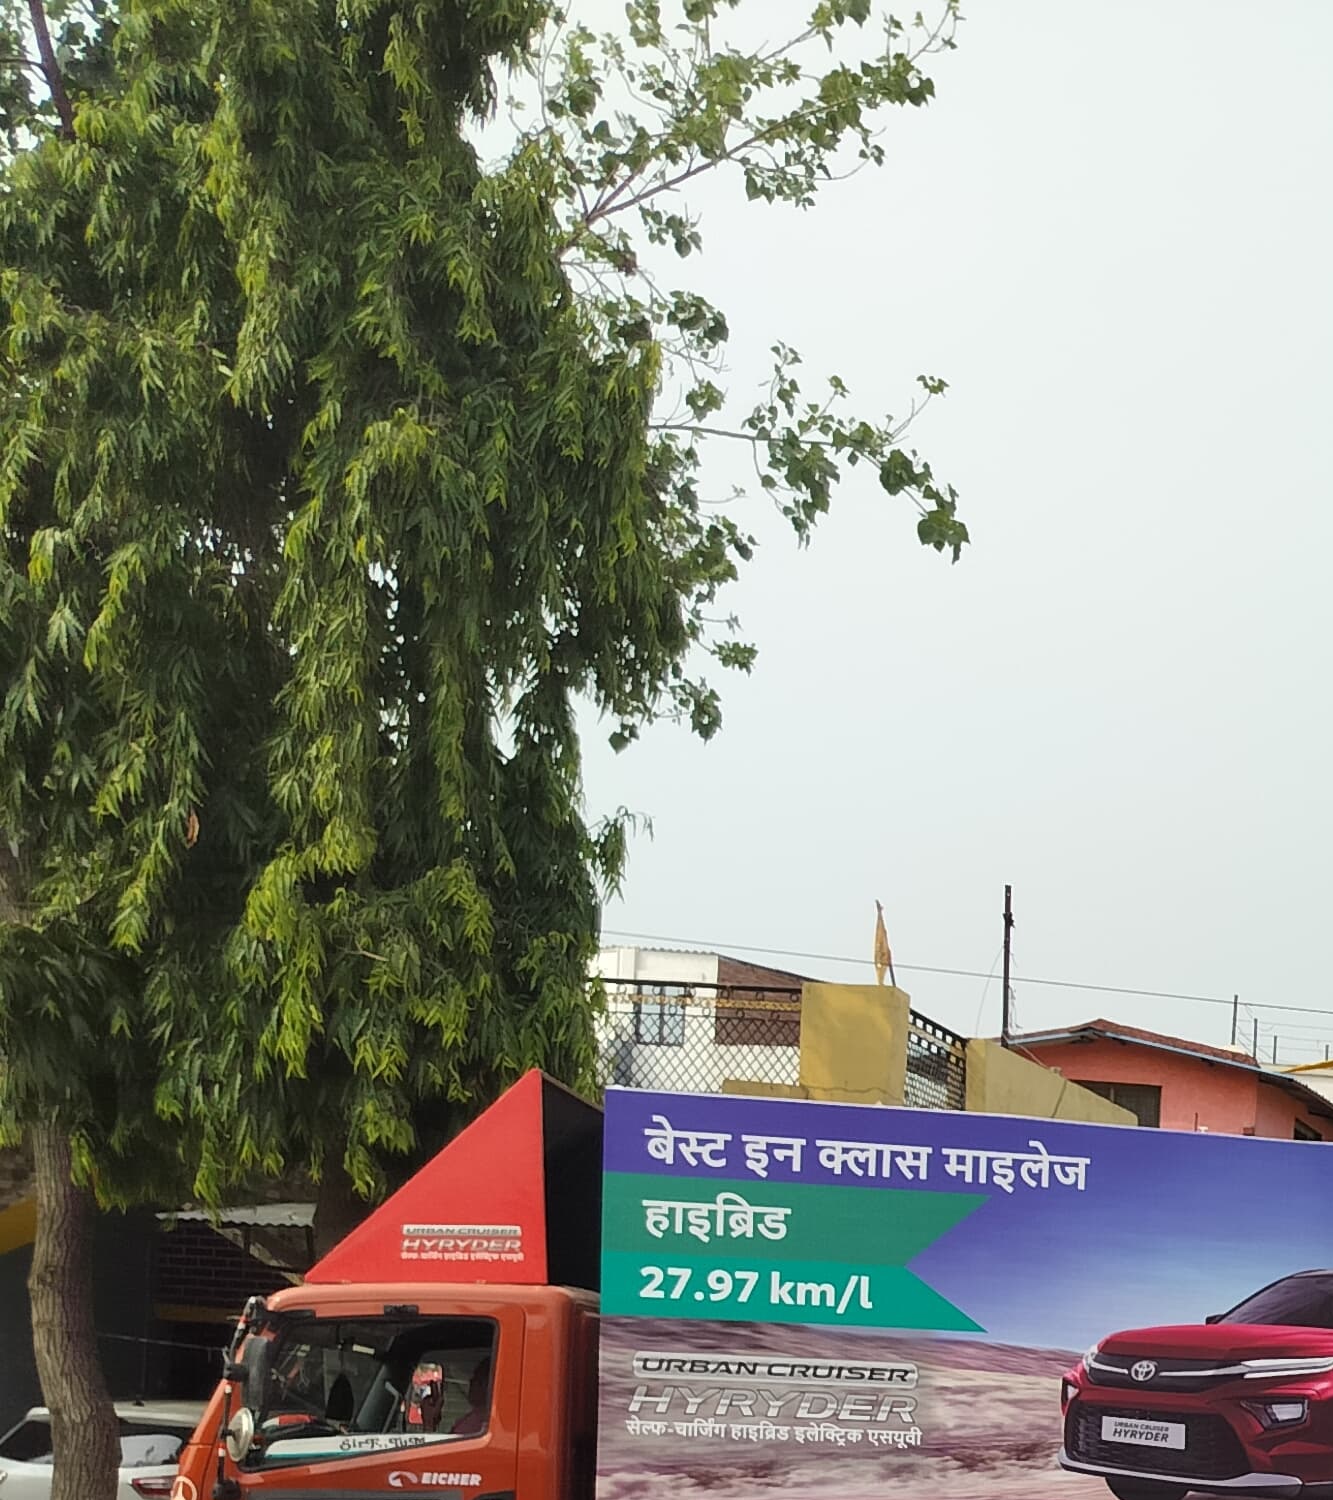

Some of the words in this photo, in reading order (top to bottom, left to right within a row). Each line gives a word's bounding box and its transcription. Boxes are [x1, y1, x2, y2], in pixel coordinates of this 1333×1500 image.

[644, 1115, 731, 1167] बेस्ट
[742, 1134, 806, 1177] इन
[816, 1140, 932, 1180] क्लास
[942, 1141, 1090, 1193] माइलेज
[643, 1192, 791, 1243] हाइब्रिड
[403, 1239, 521, 1251] HYRYDER
[640, 1267, 759, 1303] 27.97
[770, 1272, 872, 1314] km/l
[641, 1359, 757, 1375] URBAN
[767, 1364, 911, 1382] CRUISER
[628, 1386, 919, 1422] HYRYDER
[626, 1415, 726, 1438] सेल्फ-चार्जिंग
[731, 1421, 788, 1441] हाइब्रिड
[793, 1424, 861, 1446] इलेक्ट्रिक
[867, 1427, 922, 1448] एसयूवी
[1113, 1428, 1169, 1442] HYRYDER
[1114, 1421, 1138, 1429] URBAN
[1140, 1423, 1169, 1432] CRUISER
[421, 1472, 481, 1486] EICHER
